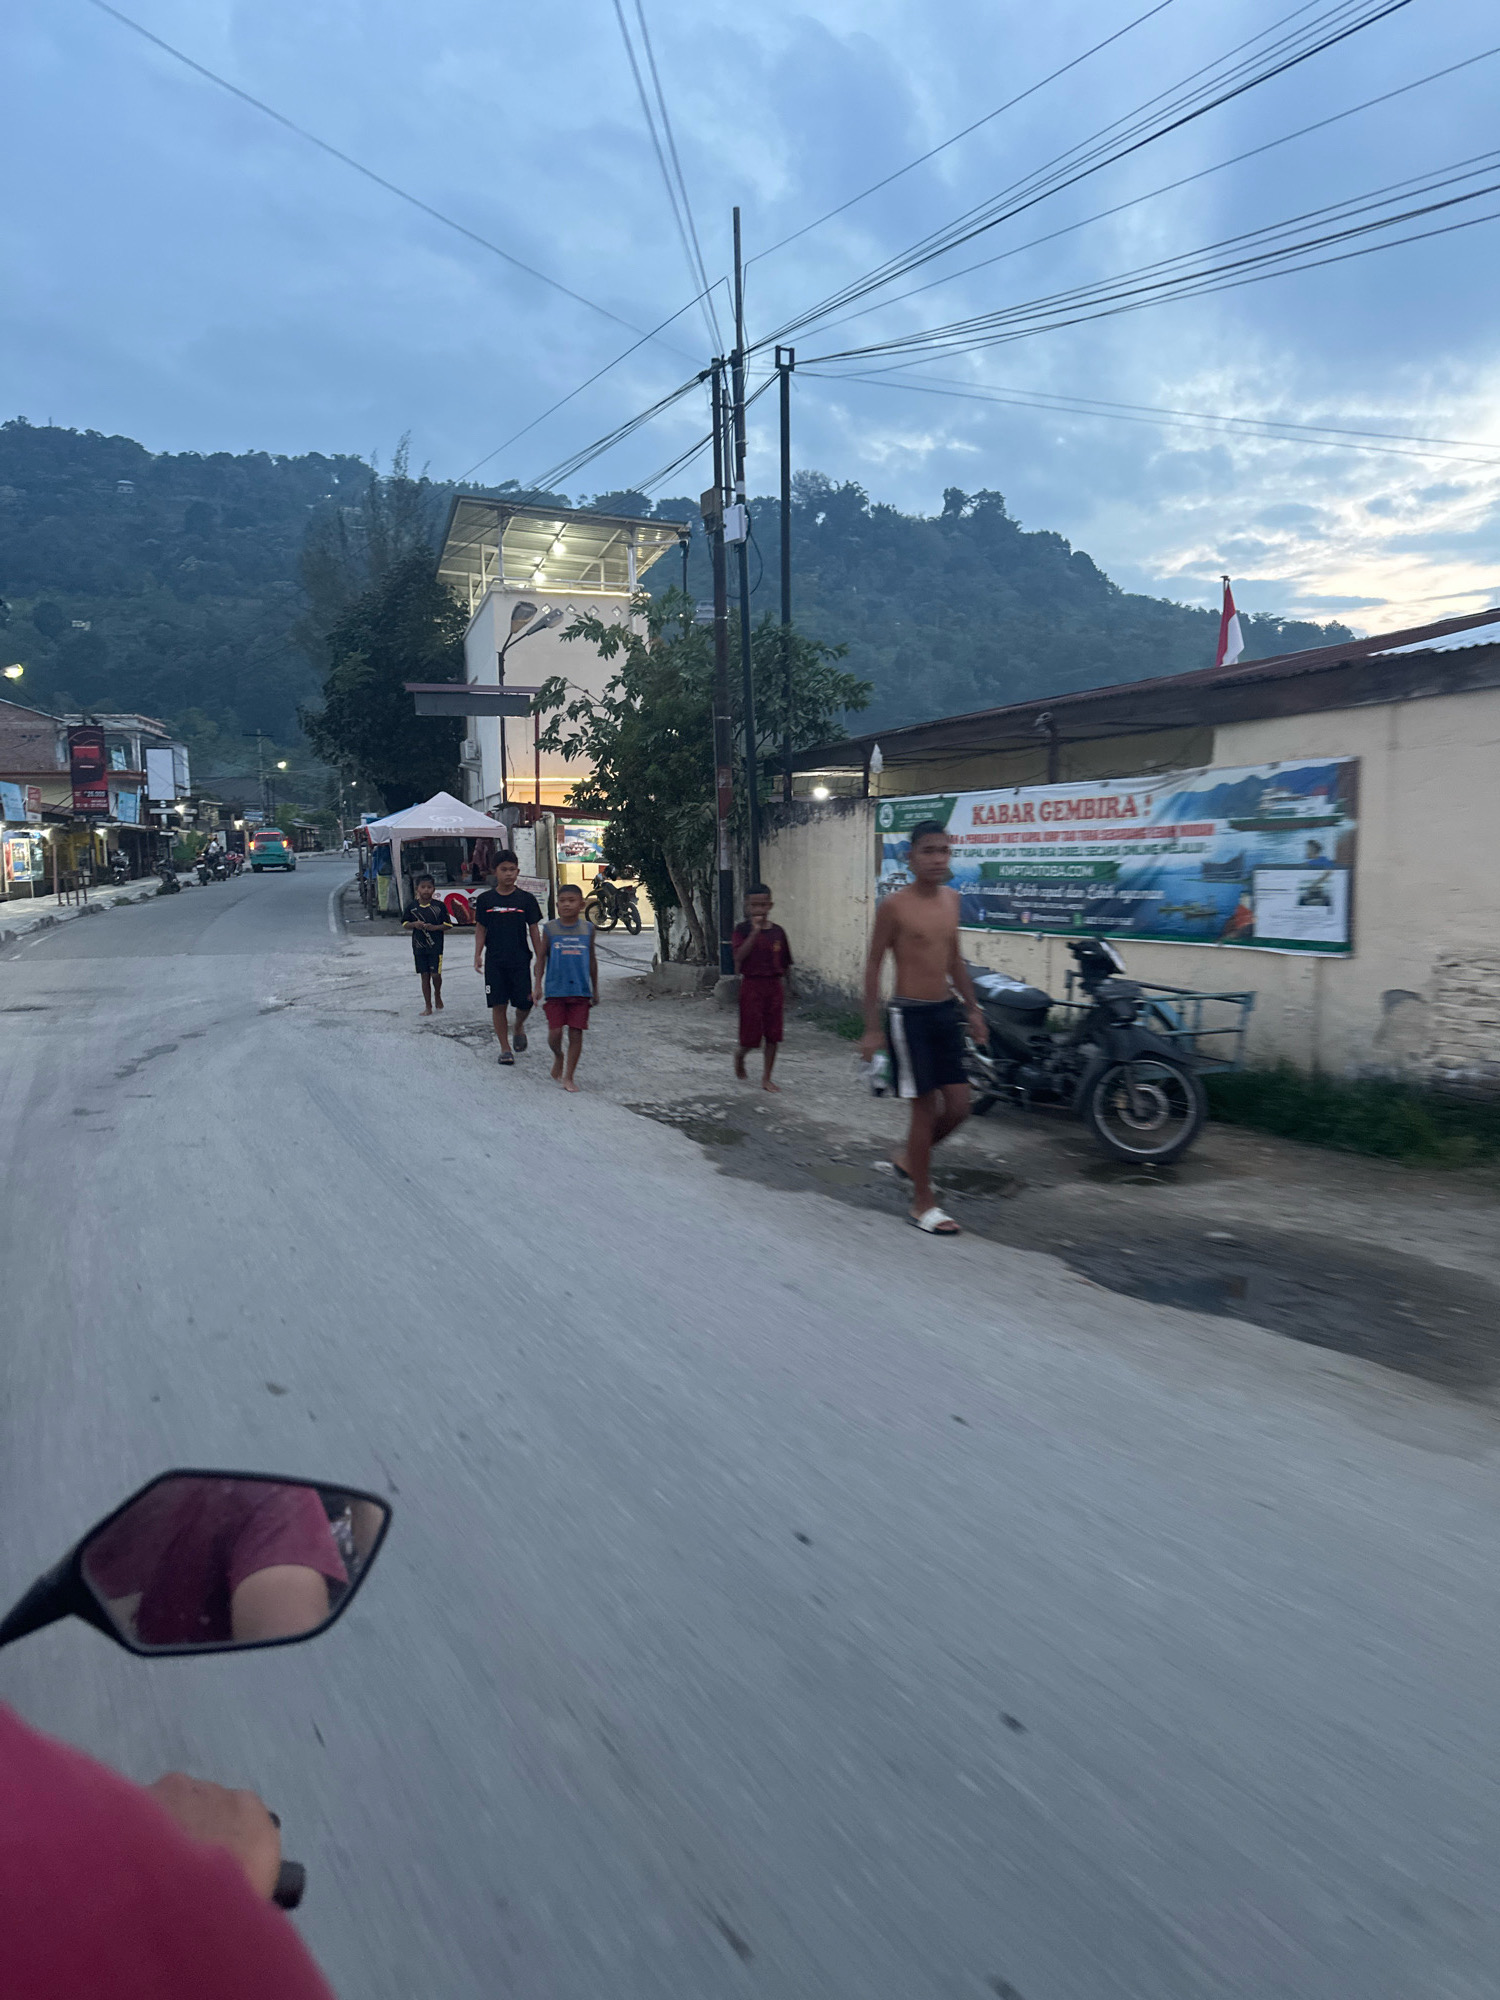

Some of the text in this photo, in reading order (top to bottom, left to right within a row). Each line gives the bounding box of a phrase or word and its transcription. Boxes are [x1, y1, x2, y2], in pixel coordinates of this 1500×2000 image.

[973, 803, 1035, 826] KABAR
[1039, 796, 1138, 822] GEMBIRA
[999, 865, 1095, 877] KMPTAOTOBA.COM
